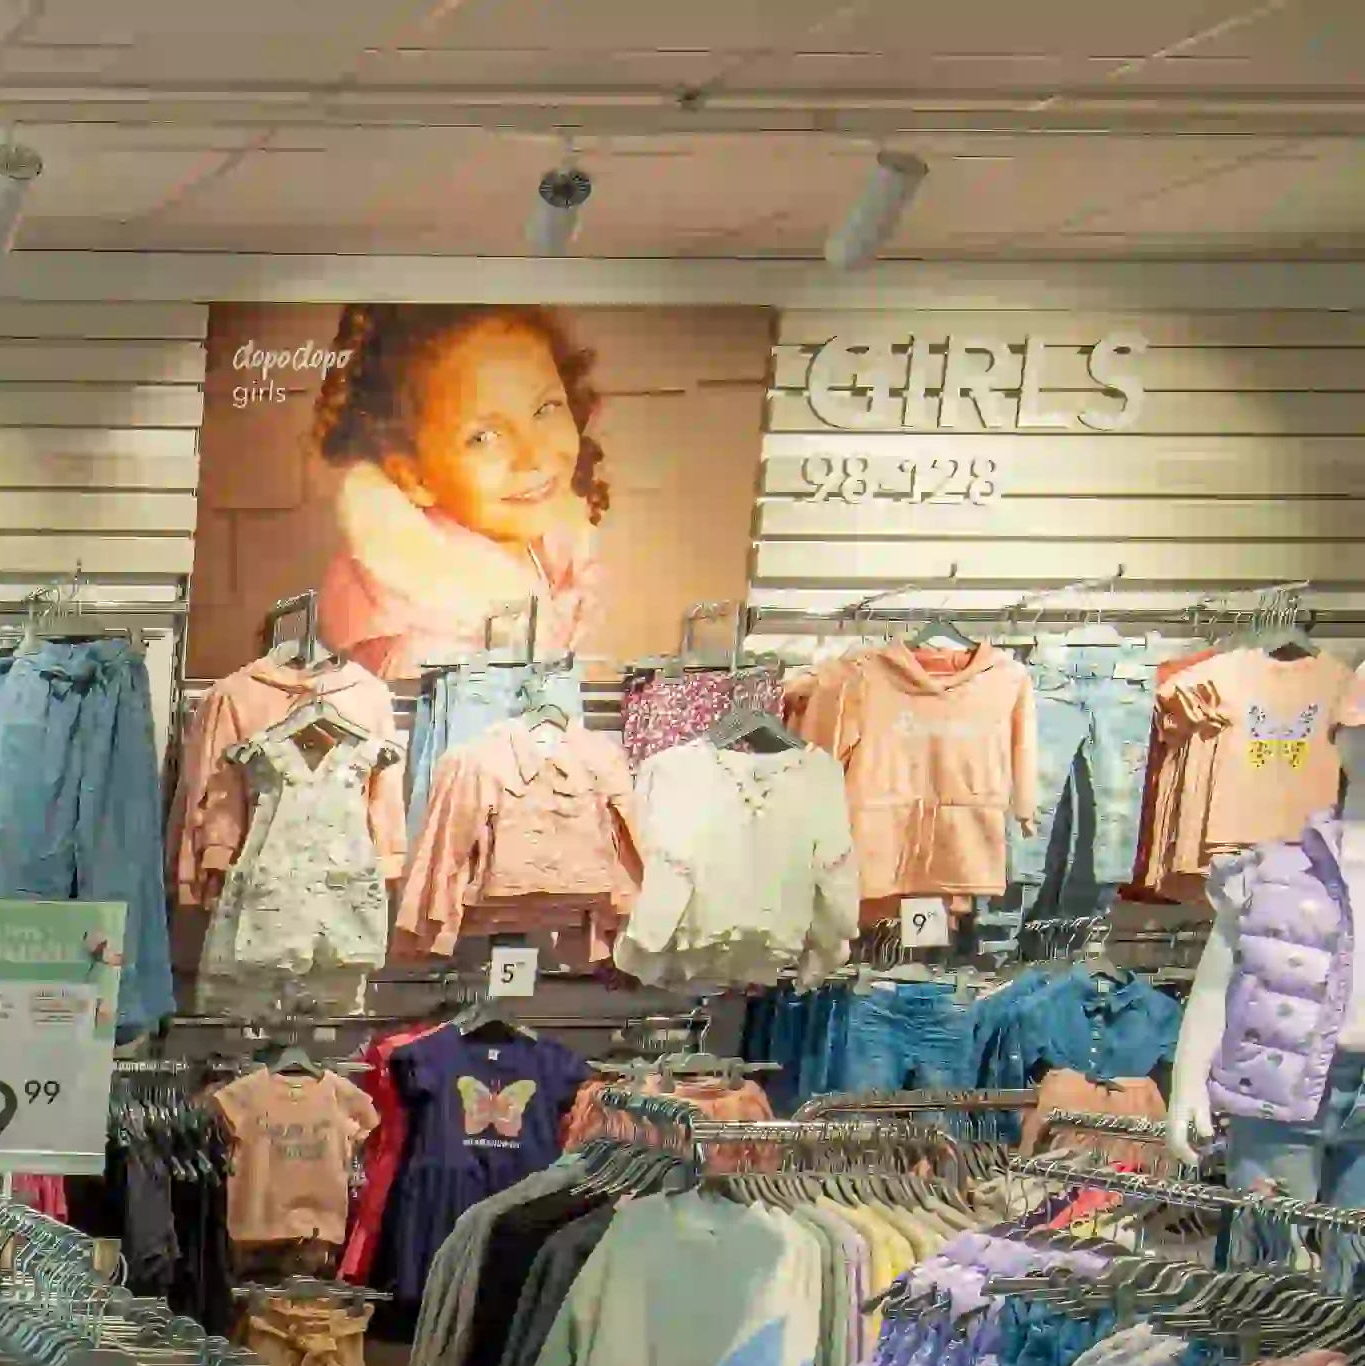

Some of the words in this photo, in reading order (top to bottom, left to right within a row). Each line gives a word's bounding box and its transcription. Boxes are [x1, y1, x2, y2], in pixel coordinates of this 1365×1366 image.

[232, 340, 354, 381] dopodopo
[806, 330, 1149, 431] GIRLS
[232, 380, 287, 409] girls
[801, 457, 997, 506] 98-128
[24, 1080, 61, 1105] 99
